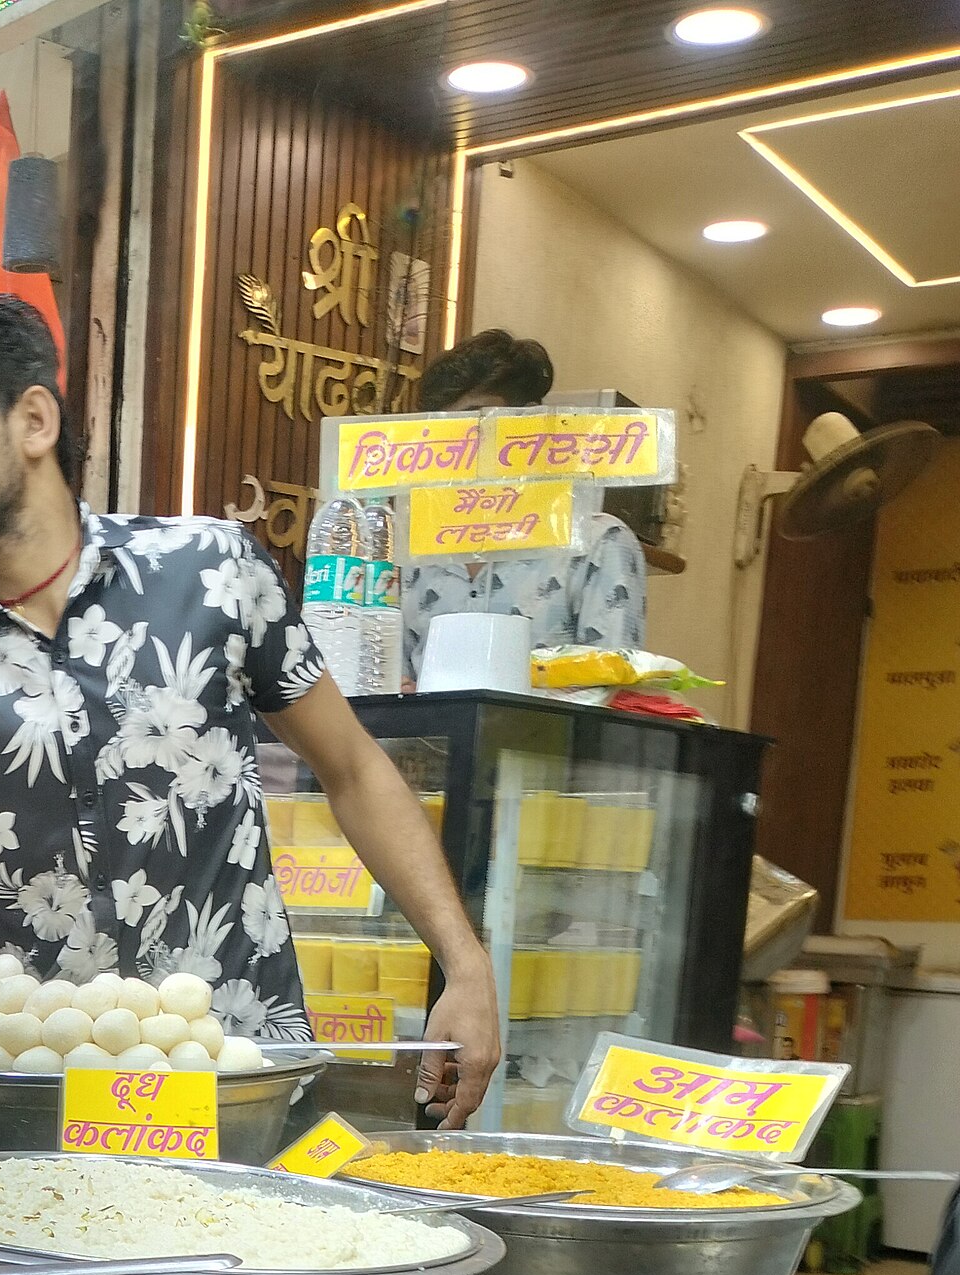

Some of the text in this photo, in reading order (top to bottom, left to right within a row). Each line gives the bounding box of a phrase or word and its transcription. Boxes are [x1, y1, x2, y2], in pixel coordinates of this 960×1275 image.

[302, 202, 379, 328] श्री
[348, 421, 651, 479] शिकंजी लस्सी
[435, 514, 540, 545] लस्सी
[305, 1004, 387, 1043] कंजी
[112, 1072, 169, 1112] दूध
[634, 1066, 791, 1116] आम
